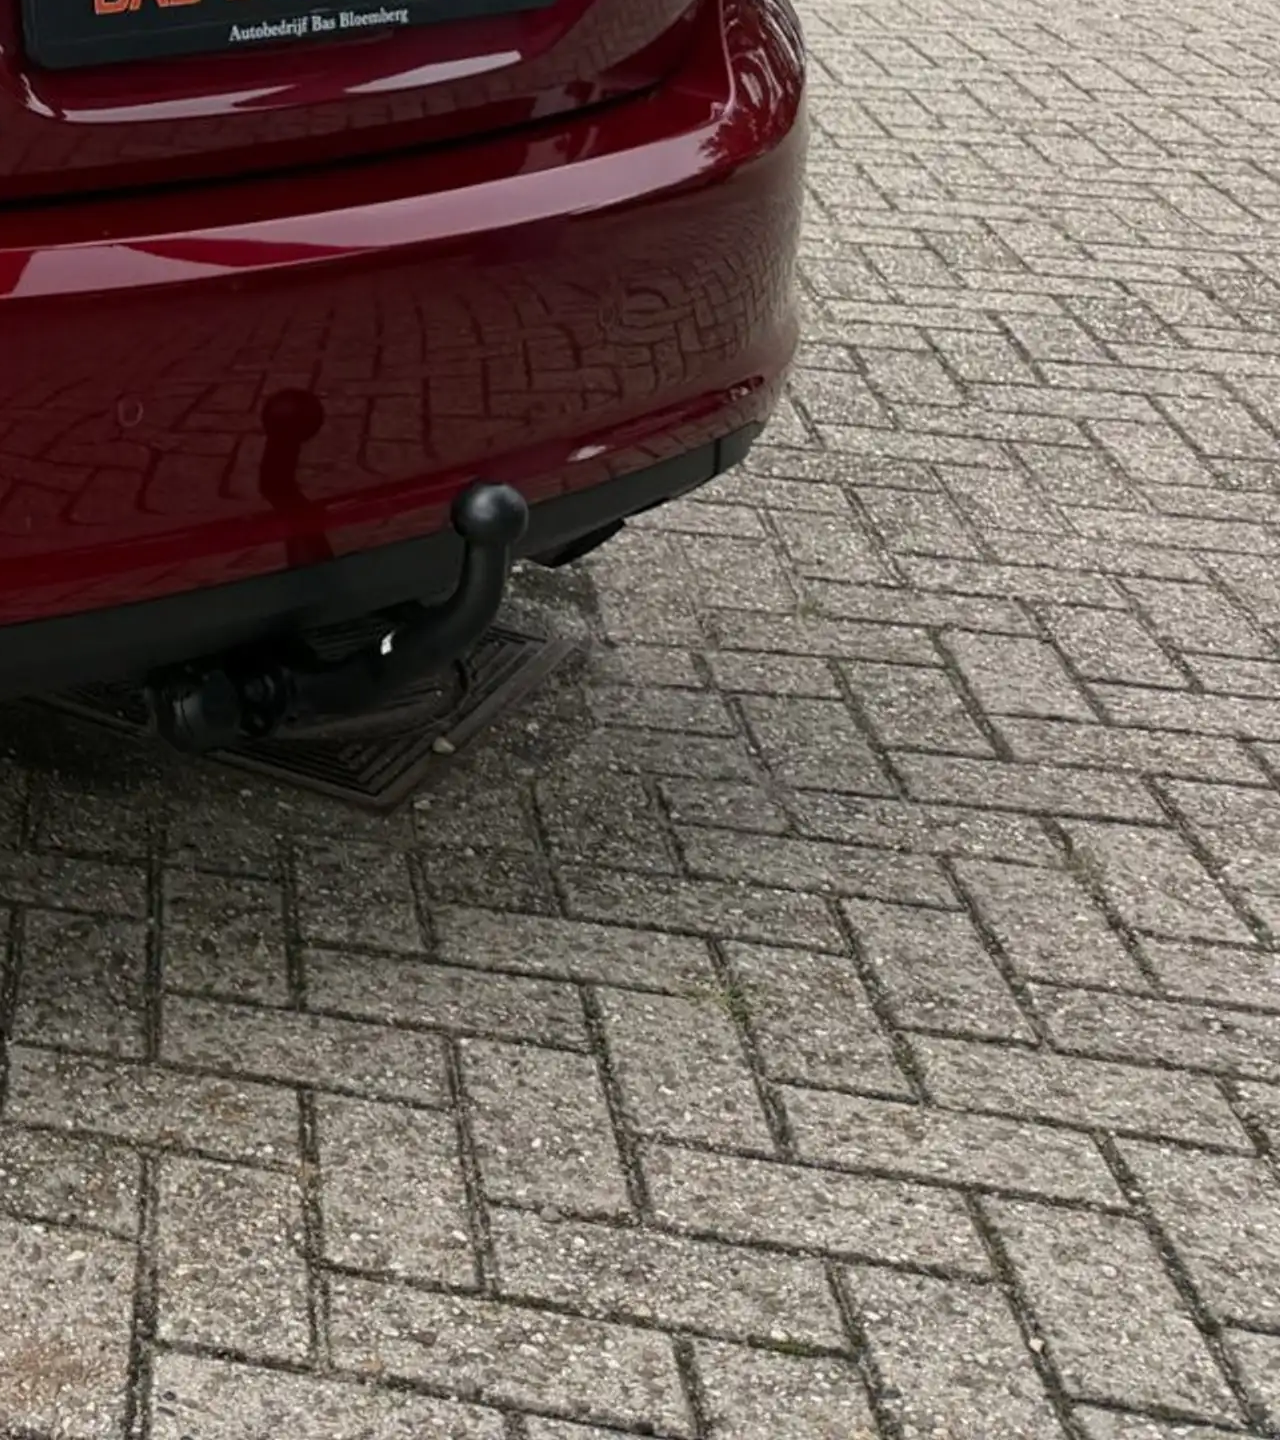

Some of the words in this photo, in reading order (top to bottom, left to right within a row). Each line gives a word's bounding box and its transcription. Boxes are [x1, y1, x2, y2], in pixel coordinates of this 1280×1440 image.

[228, 15, 309, 42] Autobedrijf
[311, 15, 336, 32] Bas
[339, 7, 409, 28] Bloemberg
